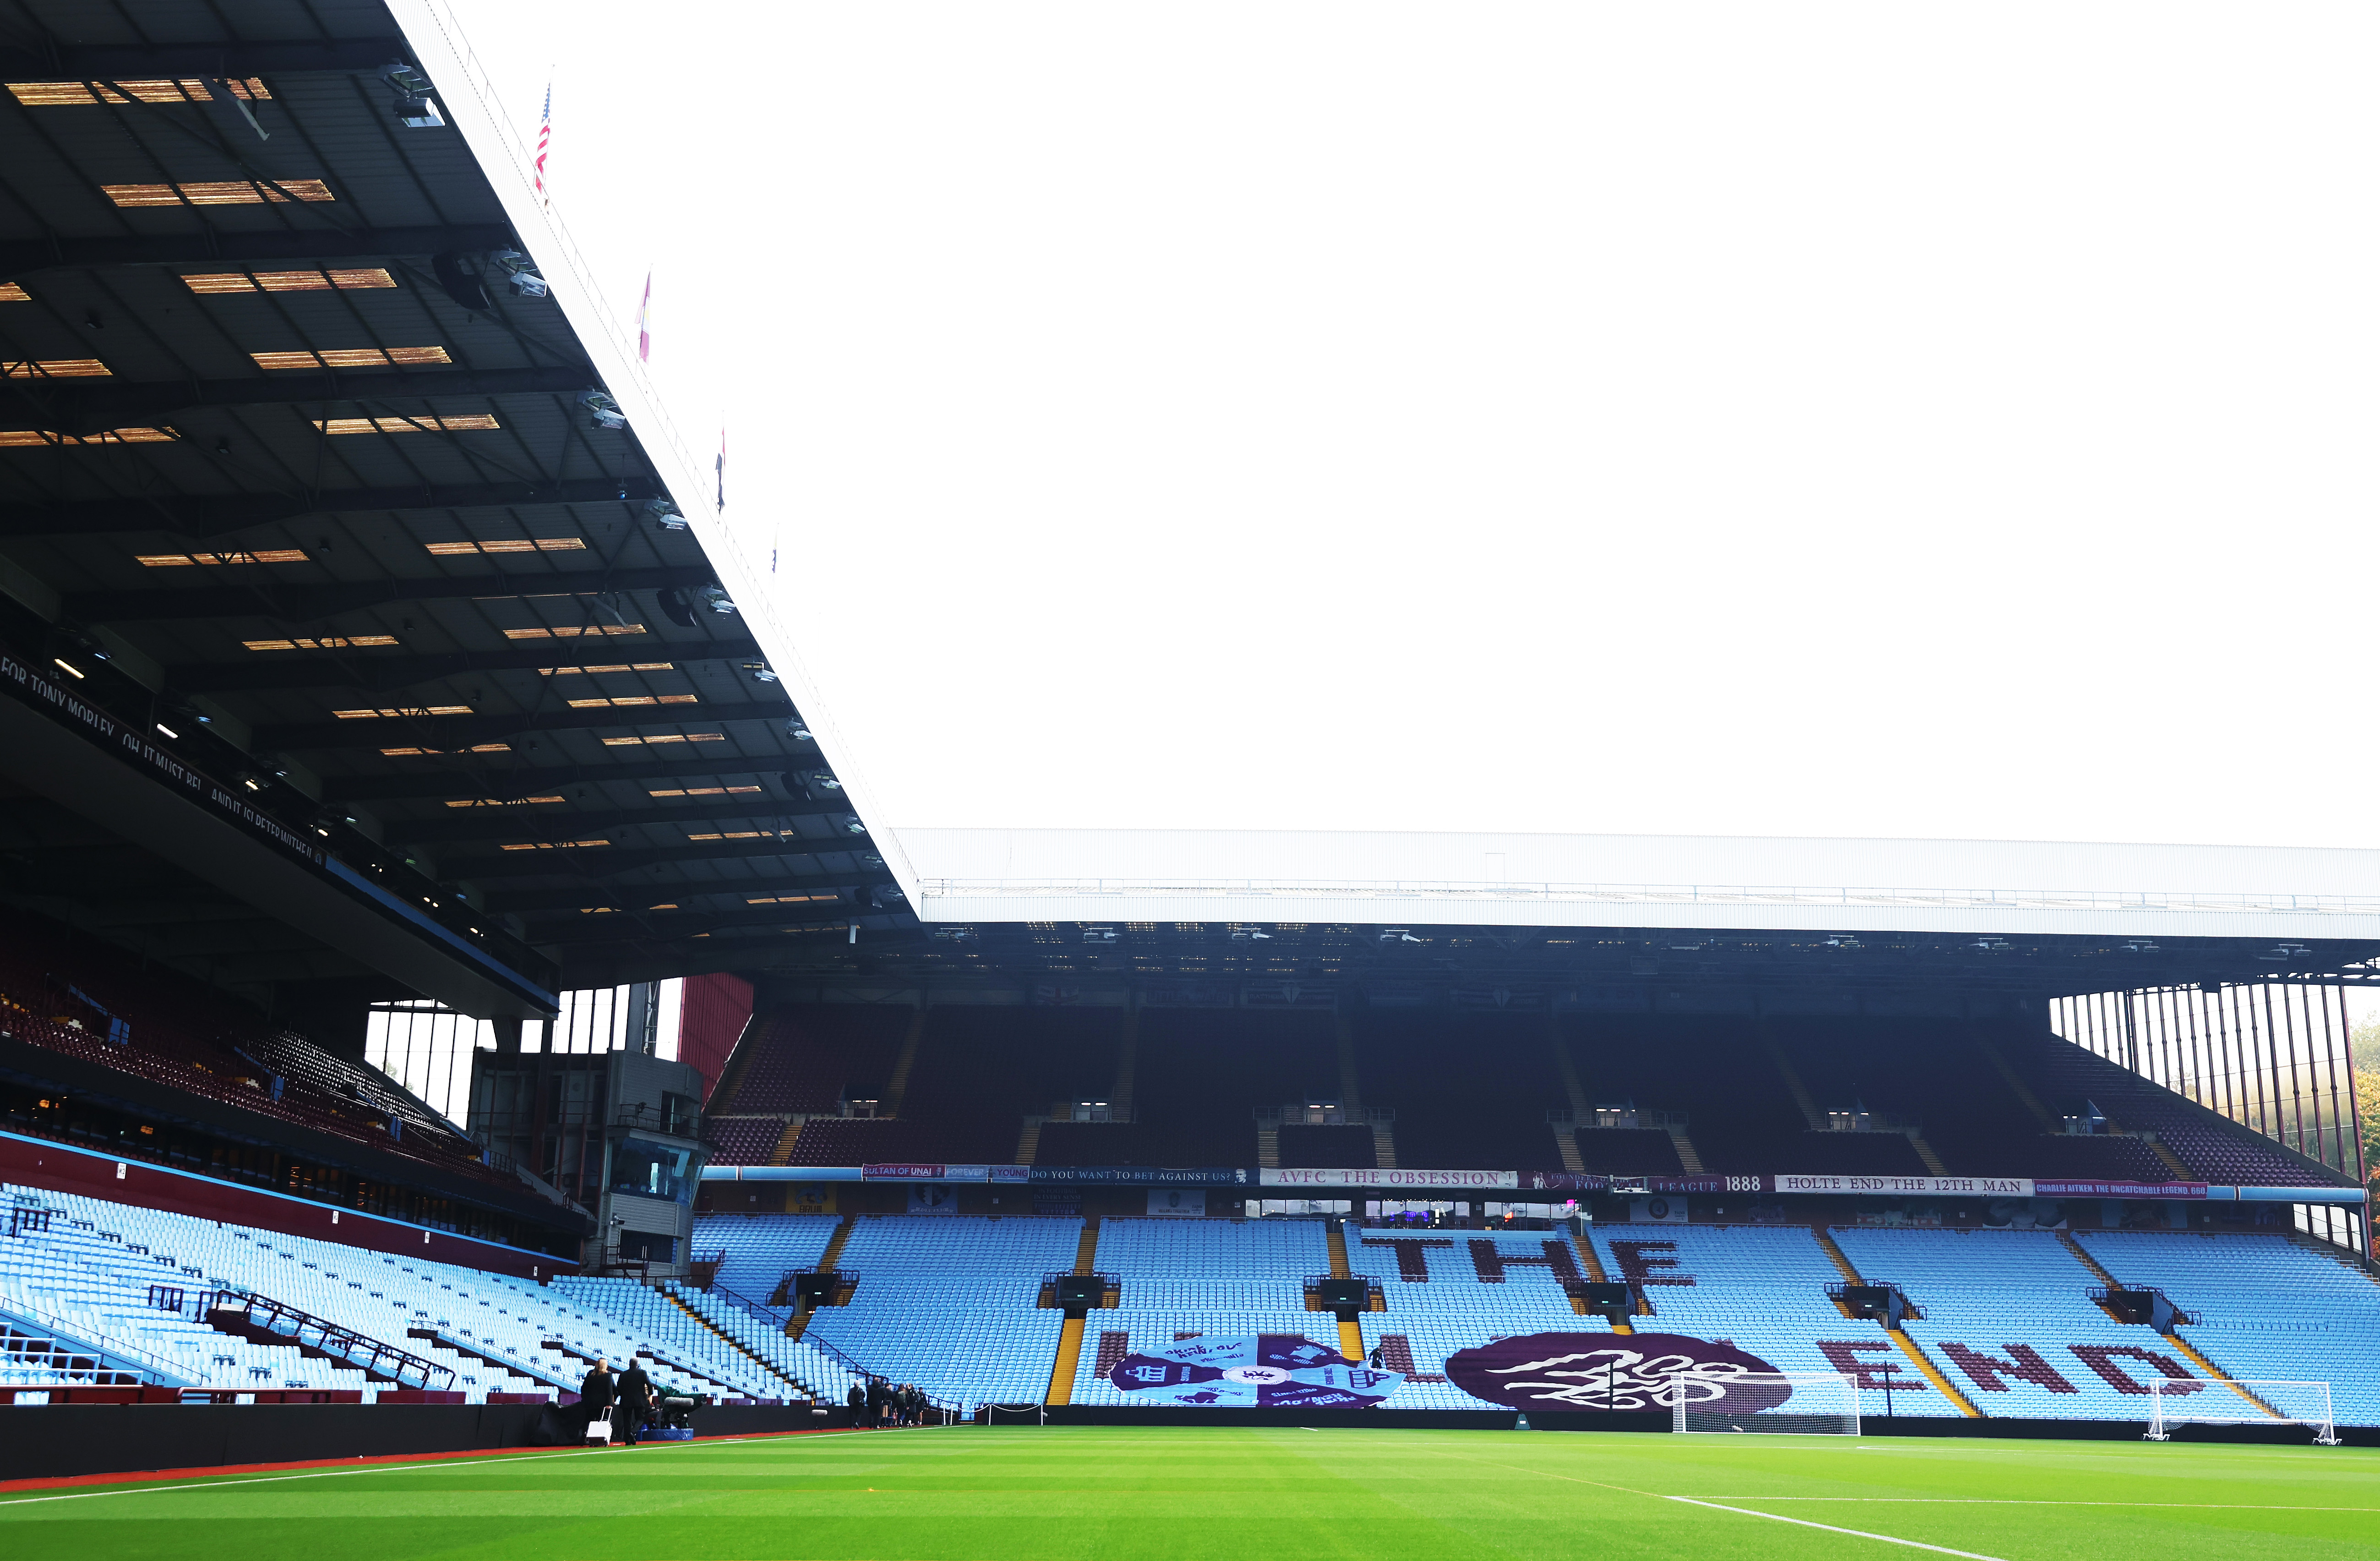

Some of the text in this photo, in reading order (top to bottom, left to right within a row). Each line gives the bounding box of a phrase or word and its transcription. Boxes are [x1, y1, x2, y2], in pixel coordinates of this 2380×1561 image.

[1, 656, 27, 684] FOR
[31, 674, 66, 706] TONY
[123, 733, 140, 753] OH
[144, 745, 155, 761] IT
[864, 1167, 896, 1175] SULTAN
[1052, 1171, 1074, 1179] YOU
[1079, 1171, 1111, 1179] WANT
[1115, 1171, 1130, 1179] TO
[1135, 1171, 1154, 1180] BET
[1159, 1172, 1209, 1180] AGAINST
[1212, 1172, 1230, 1181] US?
[1279, 1171, 1499, 1184] AVFC THE OBSESSION
[1659, 1182, 1718, 1191] LEAGUE
[1725, 1176, 1761, 1191] 1888
[1787, 1177, 2021, 1192] HOLTE END THE 12TH MAN
[2110, 1185, 2161, 1194] UNCATCHABLE
[1361, 1237, 1697, 1298] THE
[1816, 1339, 2207, 1397] END
